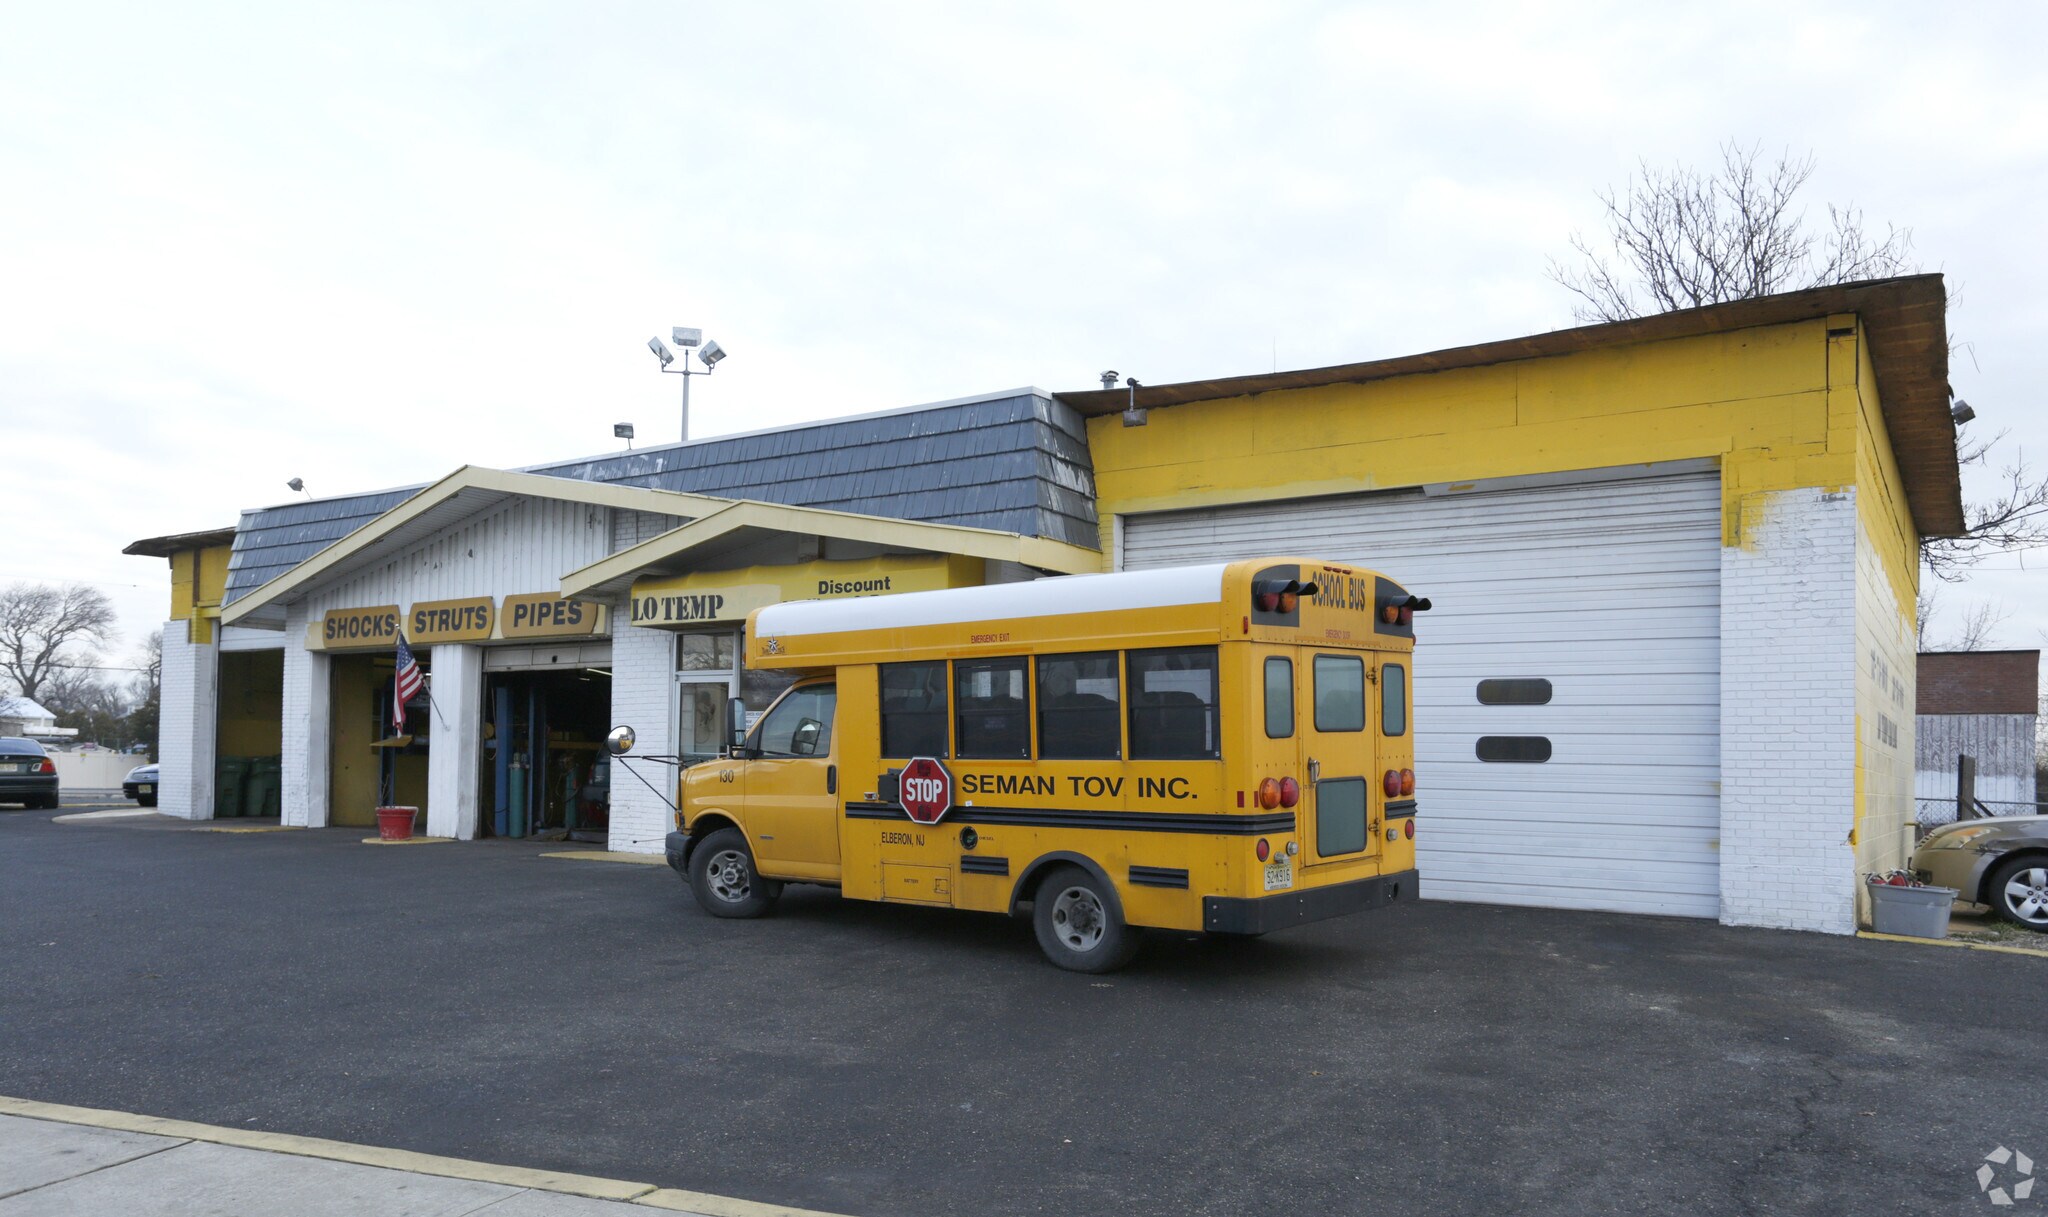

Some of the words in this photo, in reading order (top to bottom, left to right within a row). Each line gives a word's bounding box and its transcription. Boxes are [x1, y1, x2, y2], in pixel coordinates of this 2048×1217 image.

[818, 576, 891, 595] Discount
[1312, 571, 1345, 608] SCHOOL
[1349, 578, 1365, 612] BUS
[414, 605, 488, 634] STRUTS
[513, 600, 583, 628] PIPES
[631, 596, 658, 622] LO
[660, 594, 724, 621] TEMP
[325, 613, 396, 640] SHOCKS
[971, 634, 998, 643] EMERGENCY
[1000, 633, 1009, 641] EXIT
[719, 770, 734, 783] 130
[961, 773, 1055, 796] SEMAN
[1067, 776, 1125, 798] TOV
[1137, 777, 1198, 800] INC.
[905, 778, 943, 803] STOP
[881, 832, 914, 847] ELBERON,
[916, 835, 925, 846] NJ
